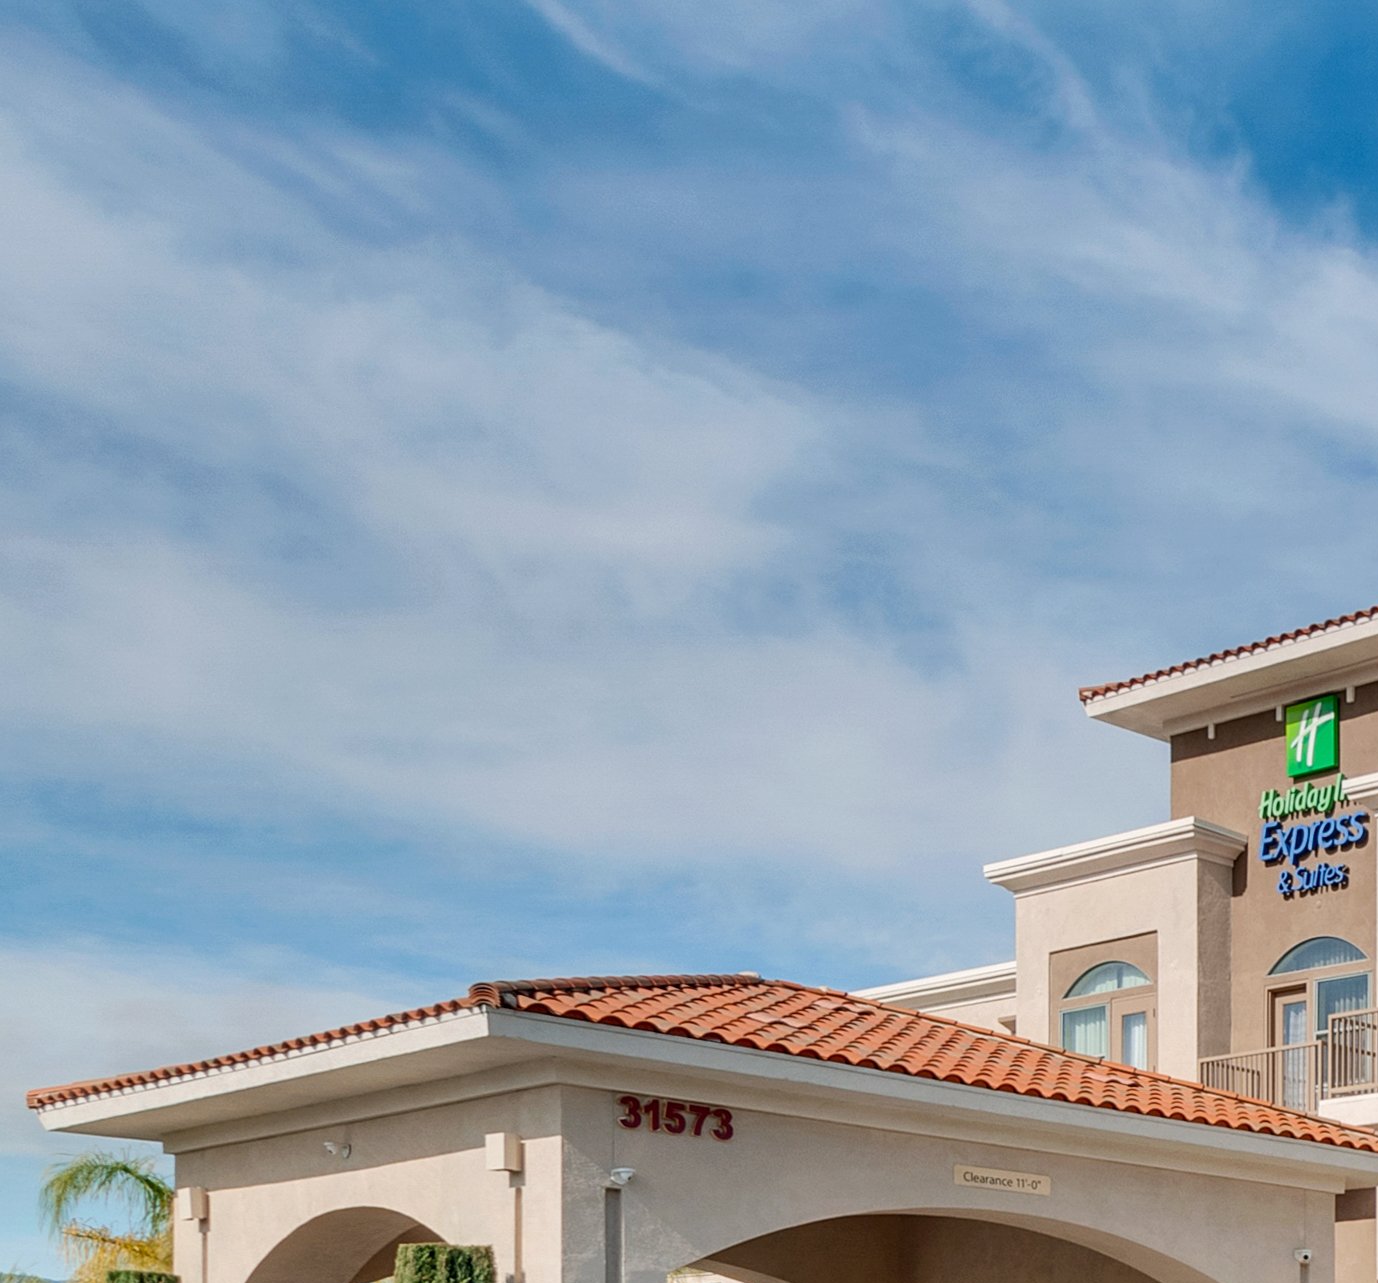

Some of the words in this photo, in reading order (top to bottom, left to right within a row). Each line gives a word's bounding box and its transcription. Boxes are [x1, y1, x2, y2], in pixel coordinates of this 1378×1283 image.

[1290, 702, 1335, 767] H
[1258, 781, 1334, 820] Holiday
[1259, 810, 1368, 867] Express
[1277, 870, 1292, 894] &
[1292, 862, 1348, 893] Suites
[617, 1095, 734, 1141] 31573
[962, 1171, 1013, 1187] Clearance
